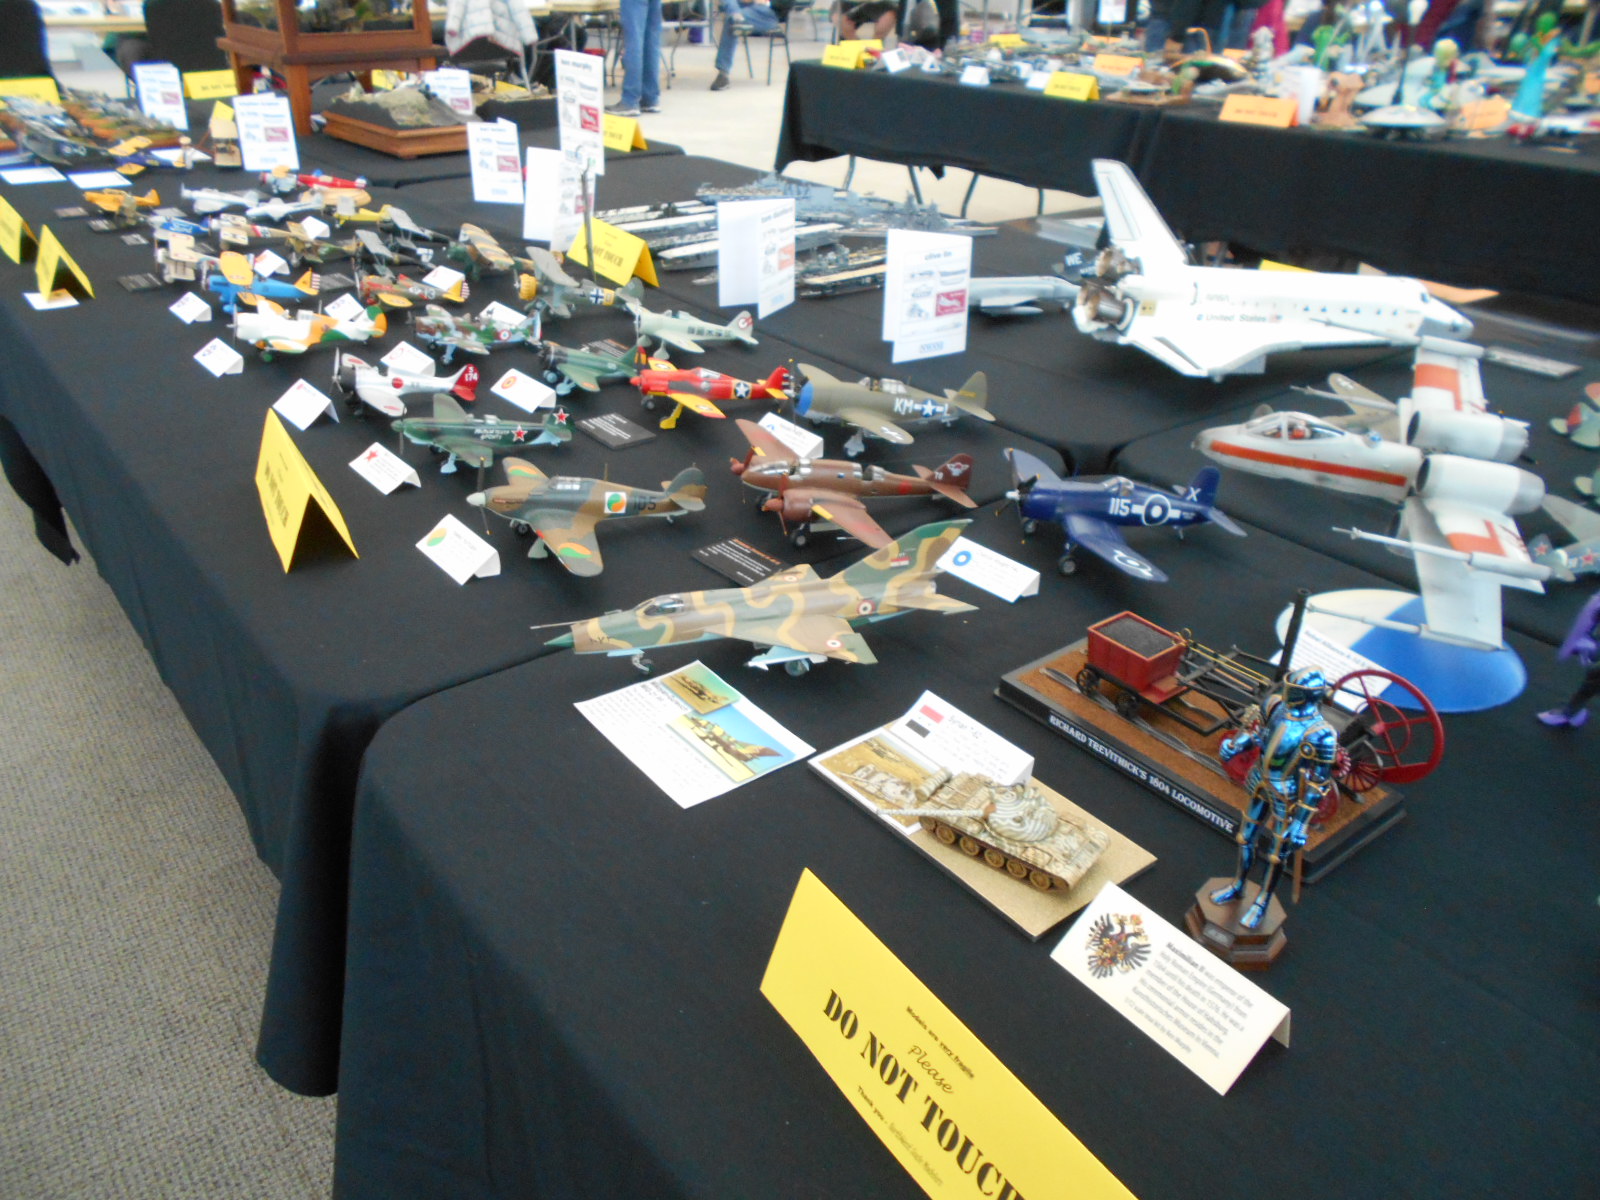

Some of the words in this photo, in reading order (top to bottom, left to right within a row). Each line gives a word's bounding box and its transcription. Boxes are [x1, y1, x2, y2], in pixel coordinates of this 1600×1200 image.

[1205, 312, 1234, 322] United
[1238, 312, 1266, 322] States
[893, 397, 913, 415] KM
[1108, 496, 1131, 516] 115
[1049, 715, 1086, 742] RICHARD
[1087, 738, 1147, 779] TREVITHICK'S
[1149, 776, 1170, 793] 1804
[1171, 789, 1233, 832] LOCOMOTIVE
[823, 988, 858, 1039] DO
[860, 1031, 919, 1104] NOT
[907, 1044, 954, 1094] Please
[953, 1055, 975, 1079] fragile
[857, 1085, 874, 1109] Thank
